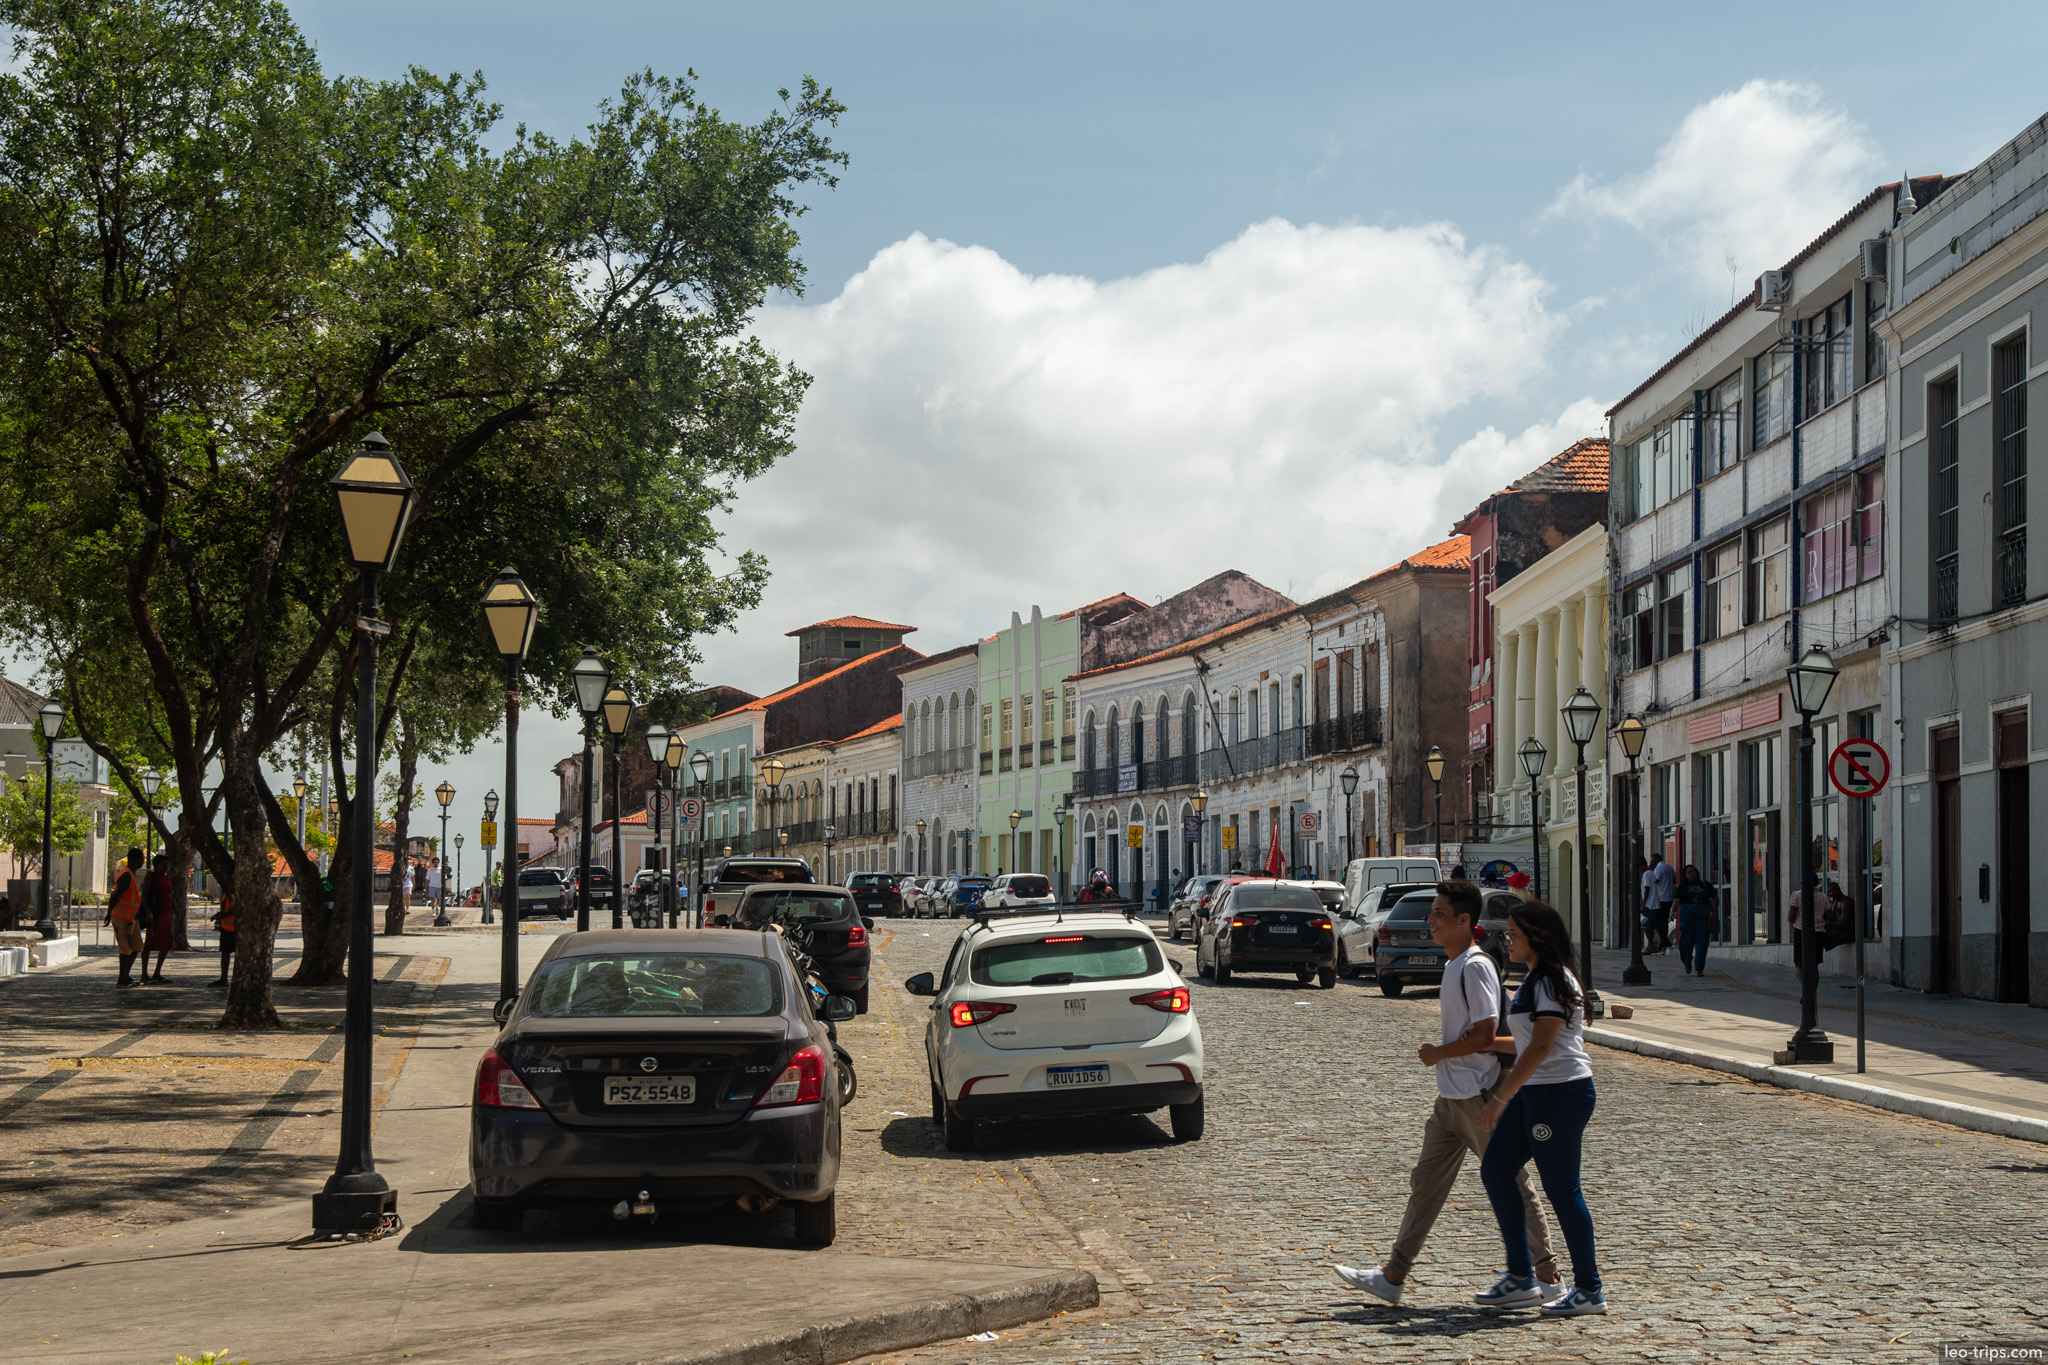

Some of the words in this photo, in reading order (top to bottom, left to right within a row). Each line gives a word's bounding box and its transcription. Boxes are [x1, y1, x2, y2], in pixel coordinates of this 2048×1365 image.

[1848, 751, 1872, 786] E
[687, 803, 695, 814] E
[1064, 998, 1087, 1010] FIAT
[1053, 1071, 1104, 1085] RUV1D56
